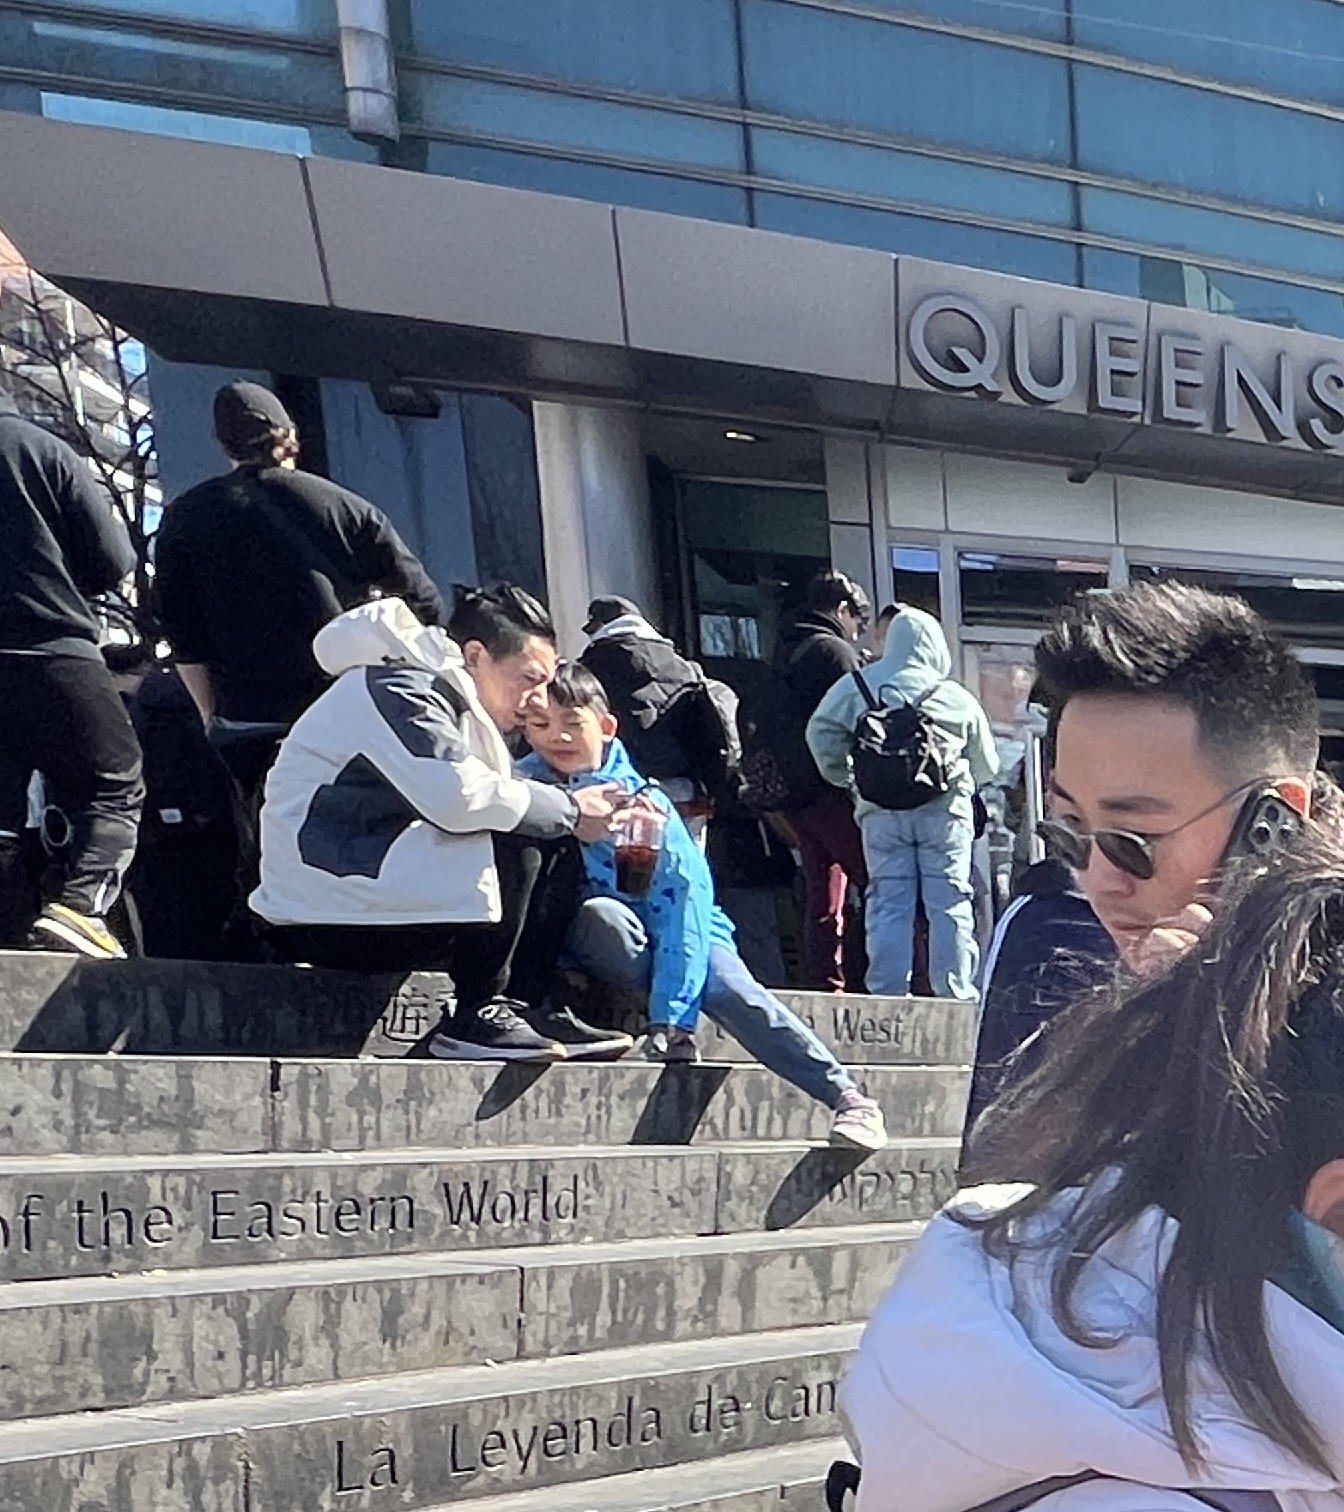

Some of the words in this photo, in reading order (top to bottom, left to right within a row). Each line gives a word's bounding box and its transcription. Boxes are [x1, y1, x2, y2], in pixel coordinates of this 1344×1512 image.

[832, 1006, 903, 1045] West
[73, 1190, 174, 1250] the
[209, 1188, 416, 1244] Eastern
[442, 1173, 579, 1229] World
[334, 1440, 399, 1495] La
[450, 1396, 663, 1477] Leyenda
[688, 1384, 740, 1435] de
